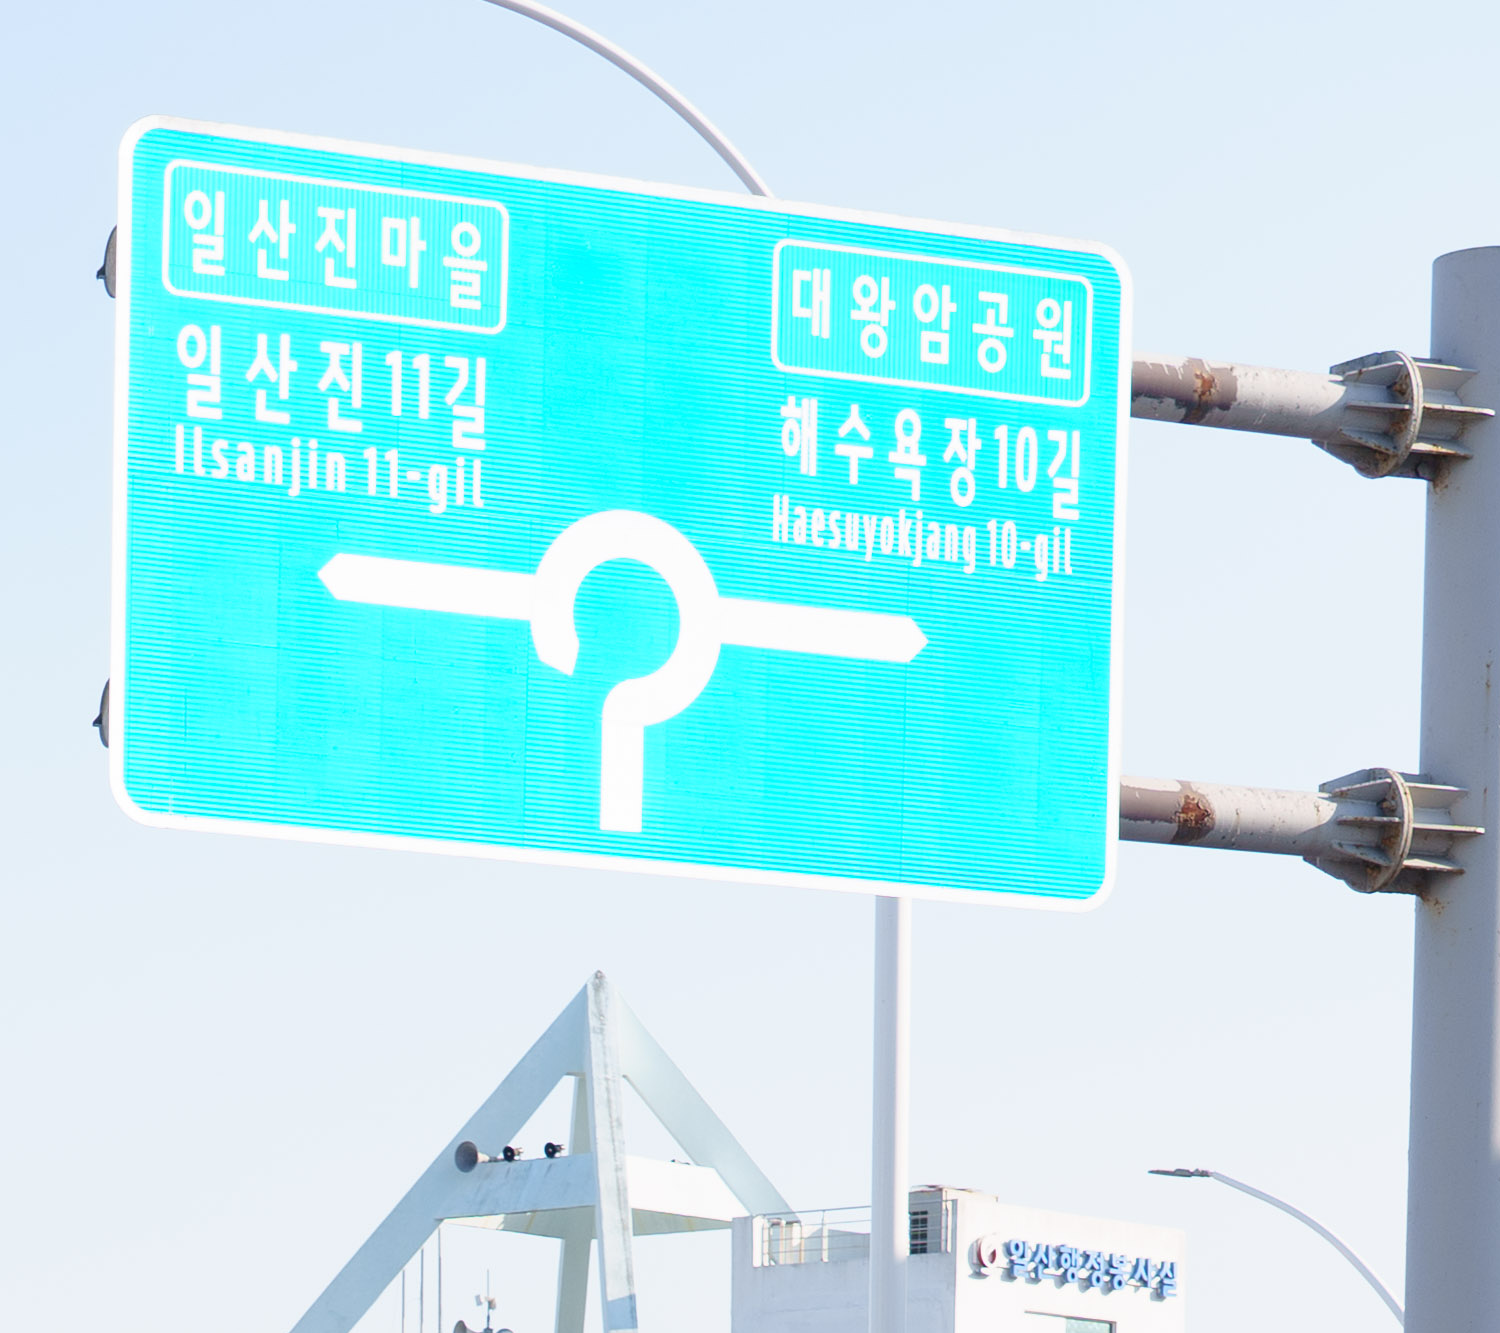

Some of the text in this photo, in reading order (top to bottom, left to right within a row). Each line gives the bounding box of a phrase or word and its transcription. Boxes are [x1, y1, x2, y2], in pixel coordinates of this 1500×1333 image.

[184, 190, 487, 310] 일산진마을
[792, 268, 1073, 380] 대왕암공원
[176, 324, 486, 450] 일산진11길
[175, 424, 484, 514] Ilsanjin 11-gil
[780, 395, 1081, 520] 해수욕장10길
[772, 494, 1073, 582] Haesuyokjang 10-gil
